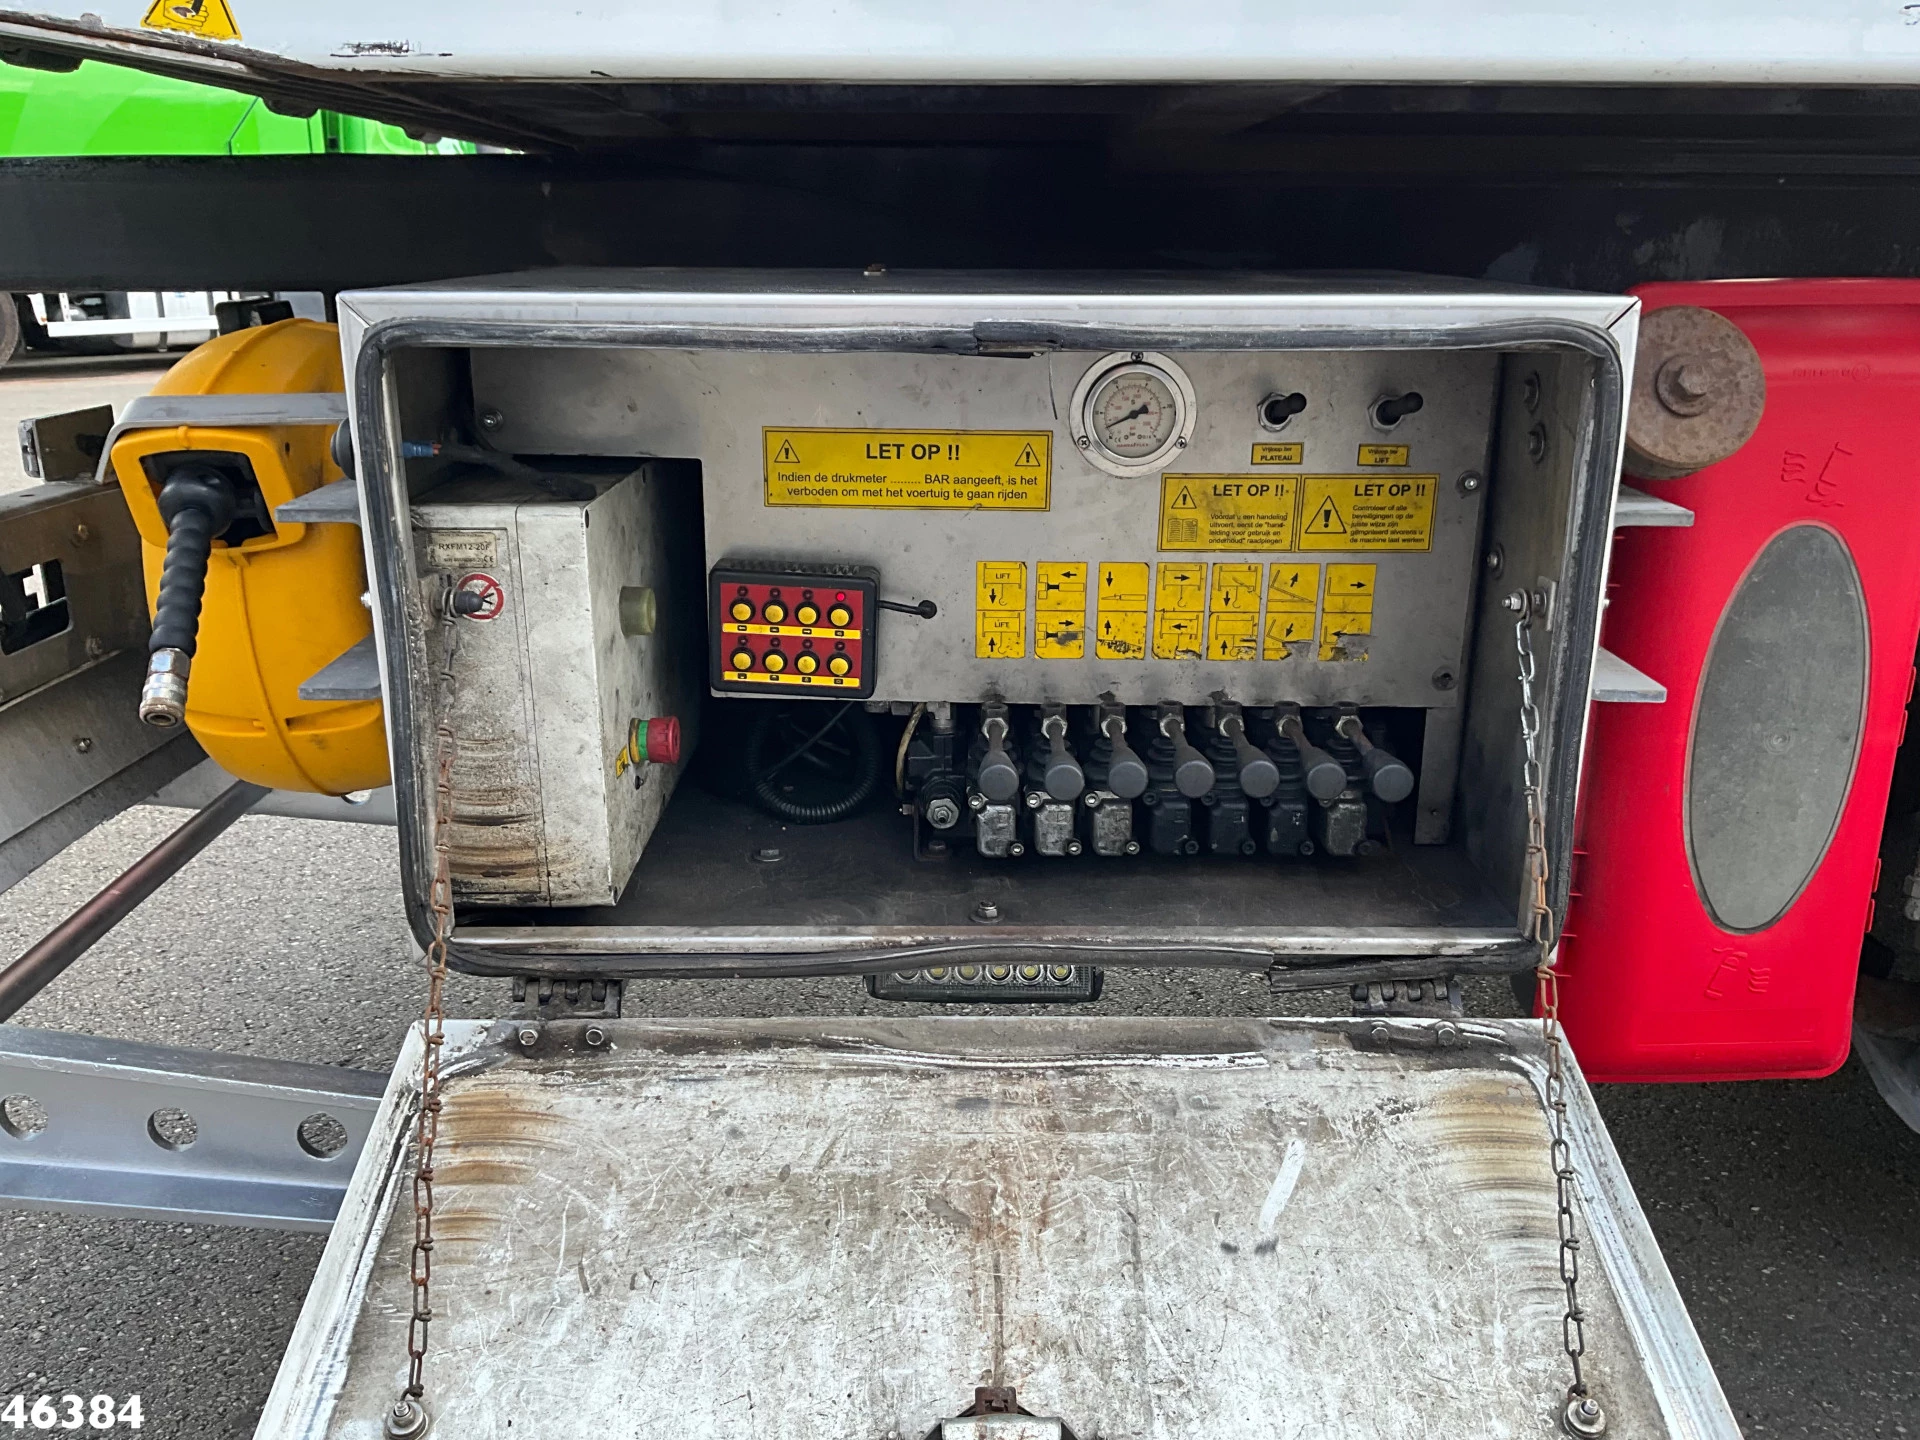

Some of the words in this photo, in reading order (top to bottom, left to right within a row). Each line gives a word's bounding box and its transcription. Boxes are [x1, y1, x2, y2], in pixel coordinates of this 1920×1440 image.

[866, 444, 904, 459] LET
[911, 444, 940, 460] OP
[948, 445, 959, 460] !!
[778, 472, 811, 482] Indien
[814, 473, 828, 482] de
[831, 473, 887, 483] drukmeter
[924, 474, 949, 484] BAR
[953, 475, 1004, 487] aangeeft,
[1008, 476, 1017, 485] is
[1020, 476, 1037, 486] het
[787, 487, 838, 496] verboden
[842, 489, 858, 497] om
[862, 488, 882, 497] met
[886, 488, 903, 497] het
[906, 488, 950, 500] voertuig
[953, 489, 963, 498] te
[967, 491, 994, 500] gaan
[998, 490, 1027, 501] rijden
[1213, 484, 1243, 496] LET
[1248, 484, 1269, 496] OP
[1275, 485, 1284, 496] !!
[1354, 484, 1384, 496] LET
[1388, 484, 1411, 496] OP
[1416, 484, 1425, 496] !!
